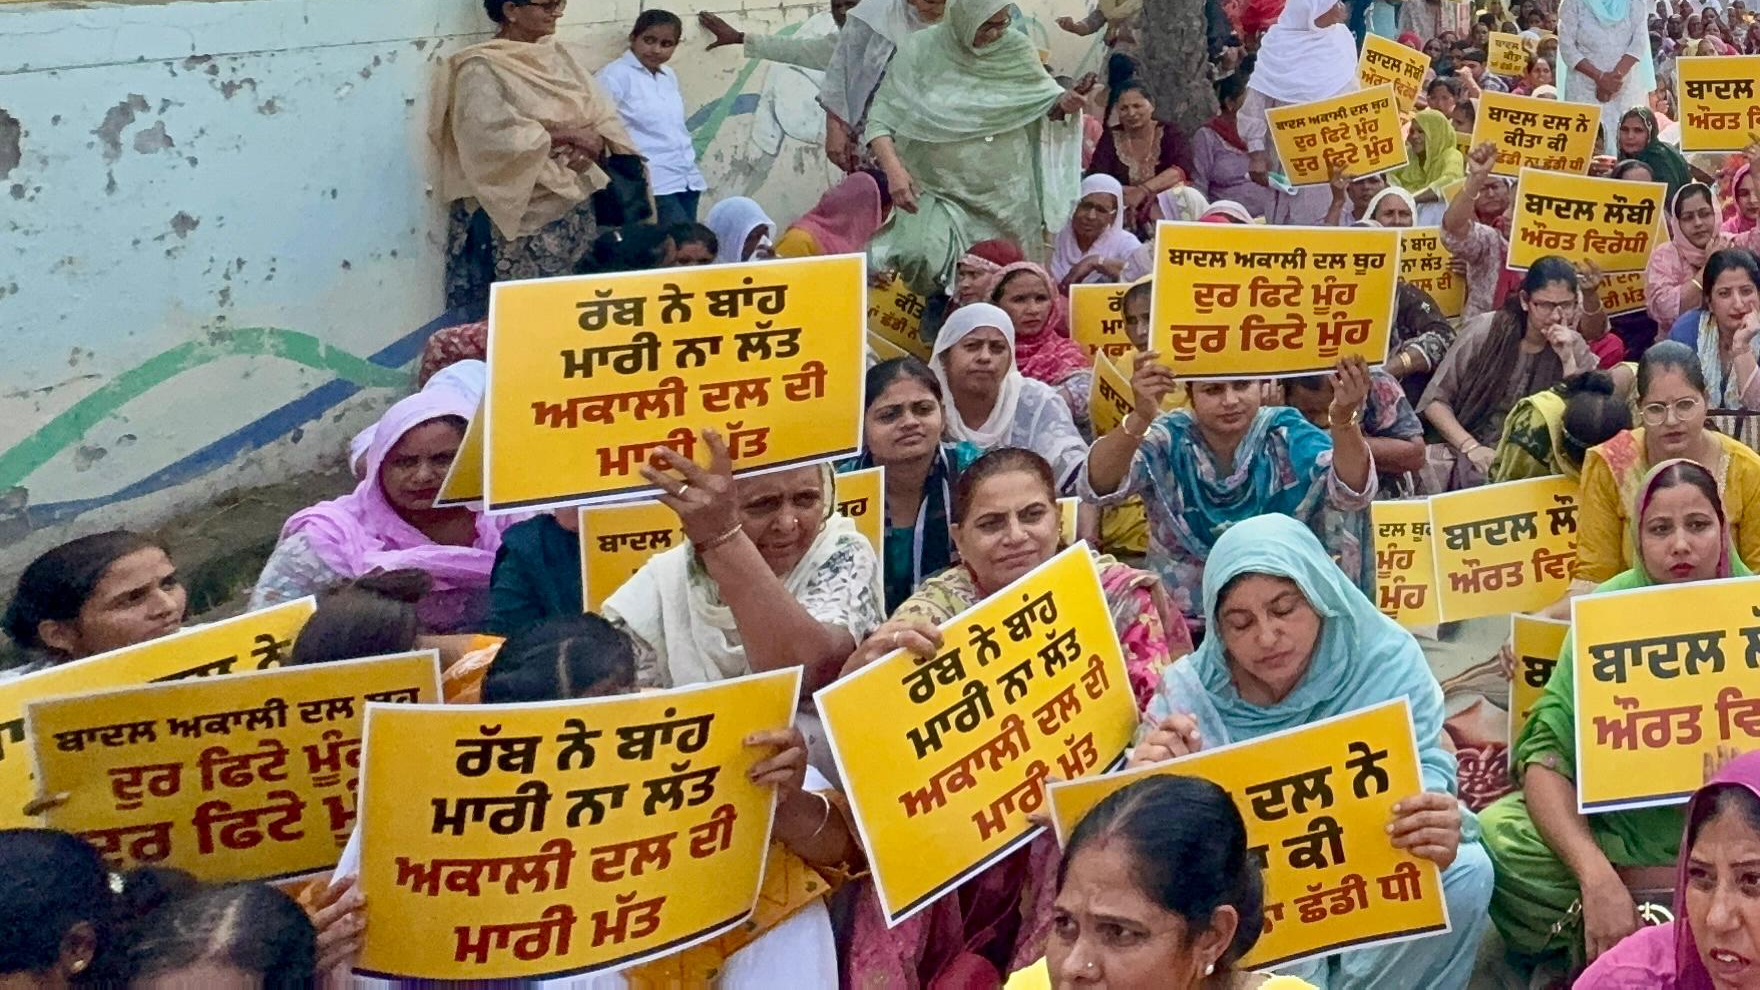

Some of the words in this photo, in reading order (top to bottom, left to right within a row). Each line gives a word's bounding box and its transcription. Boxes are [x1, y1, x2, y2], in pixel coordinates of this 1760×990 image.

[1685, 75, 1753, 100] ਬਾਦਲ
[1688, 102, 1741, 130] ਔਰਤ
[1525, 194, 1596, 224] ਬਾਦਲ
[1603, 195, 1655, 226] ਲੌਬੀ
[1168, 248, 1228, 267] ਬਾਦਲ
[1234, 247, 1307, 269] ਅਕਾਲੀ
[1313, 253, 1347, 269] ਦਲ
[1520, 221, 1576, 250] ਔਰਤ
[1582, 227, 1648, 256] ਵਿਰੋਧੀ
[577, 290, 648, 331] ਰੱਬ
[659, 284, 695, 323] ਨੇ
[706, 278, 788, 318] ਬਾਂਹ
[1249, 276, 1303, 308] ਫਿਟੇ
[1312, 275, 1357, 314] ਮੂੰਹ
[562, 331, 661, 380] ਮਾਰੀ
[675, 334, 721, 369] ਨਾ
[734, 323, 801, 361] ਲੱਤ
[1240, 313, 1307, 351] ਫਿਟੇ
[1317, 311, 1372, 357] ਮੂੰਹ
[533, 376, 688, 429] ਅਕਾਲੀ
[700, 379, 770, 412] ਦਲ
[783, 361, 828, 401] ਦੀ
[597, 529, 672, 552] ਬਾਦਲ
[1379, 522, 1406, 538] ਦਲ
[1443, 511, 1538, 551] ਬਾਦਲ
[1448, 558, 1523, 594] ਔਰਤ
[976, 627, 1001, 665] ਨੇ
[1003, 590, 1056, 643] ਬਾਂਹ
[1589, 629, 1725, 683] ਬਾਦਲ
[906, 679, 993, 760] ਮਾਰੀ
[998, 658, 1033, 705] ਨਾ
[1038, 627, 1082, 681] ਲੱਤ
[52, 720, 156, 752] ਬਾਦਲ
[167, 698, 289, 738] ਅਕਾਲੀ
[298, 696, 355, 723] ਦਲ
[455, 723, 538, 778] ਰੱਬ
[556, 720, 602, 771] ਨੇ
[617, 709, 714, 761] ਬਾਂਹ
[899, 717, 1032, 819] ਅਕਾਲੀ
[1033, 686, 1083, 736] ਦਲ
[1081, 656, 1110, 697] ਦੀ
[1594, 695, 1702, 750] ਔਰਤ
[198, 739, 289, 791] ਫਿਟੇ
[1055, 732, 1098, 780] ਮੱਤ
[1245, 766, 1334, 822] ਦਲ
[1347, 740, 1390, 799] ਨੇ
[193, 791, 306, 854] ਫਿਟੇ
[430, 781, 551, 835] ਮਾਰੀ
[567, 778, 627, 828] ਨਾ
[643, 765, 721, 816] ਲੱਤ
[394, 839, 572, 896] ਅਕਾਲੀ
[591, 834, 678, 884] ਦਲ
[689, 803, 737, 859] ਦੀ
[1282, 816, 1345, 870] ਕੀ
[1293, 873, 1368, 926] ਛੱਡੀ
[1376, 863, 1421, 903] ਧੀ
[454, 907, 577, 964] ਮਾਰੀ
[589, 894, 666, 948] ਮੱਤ
